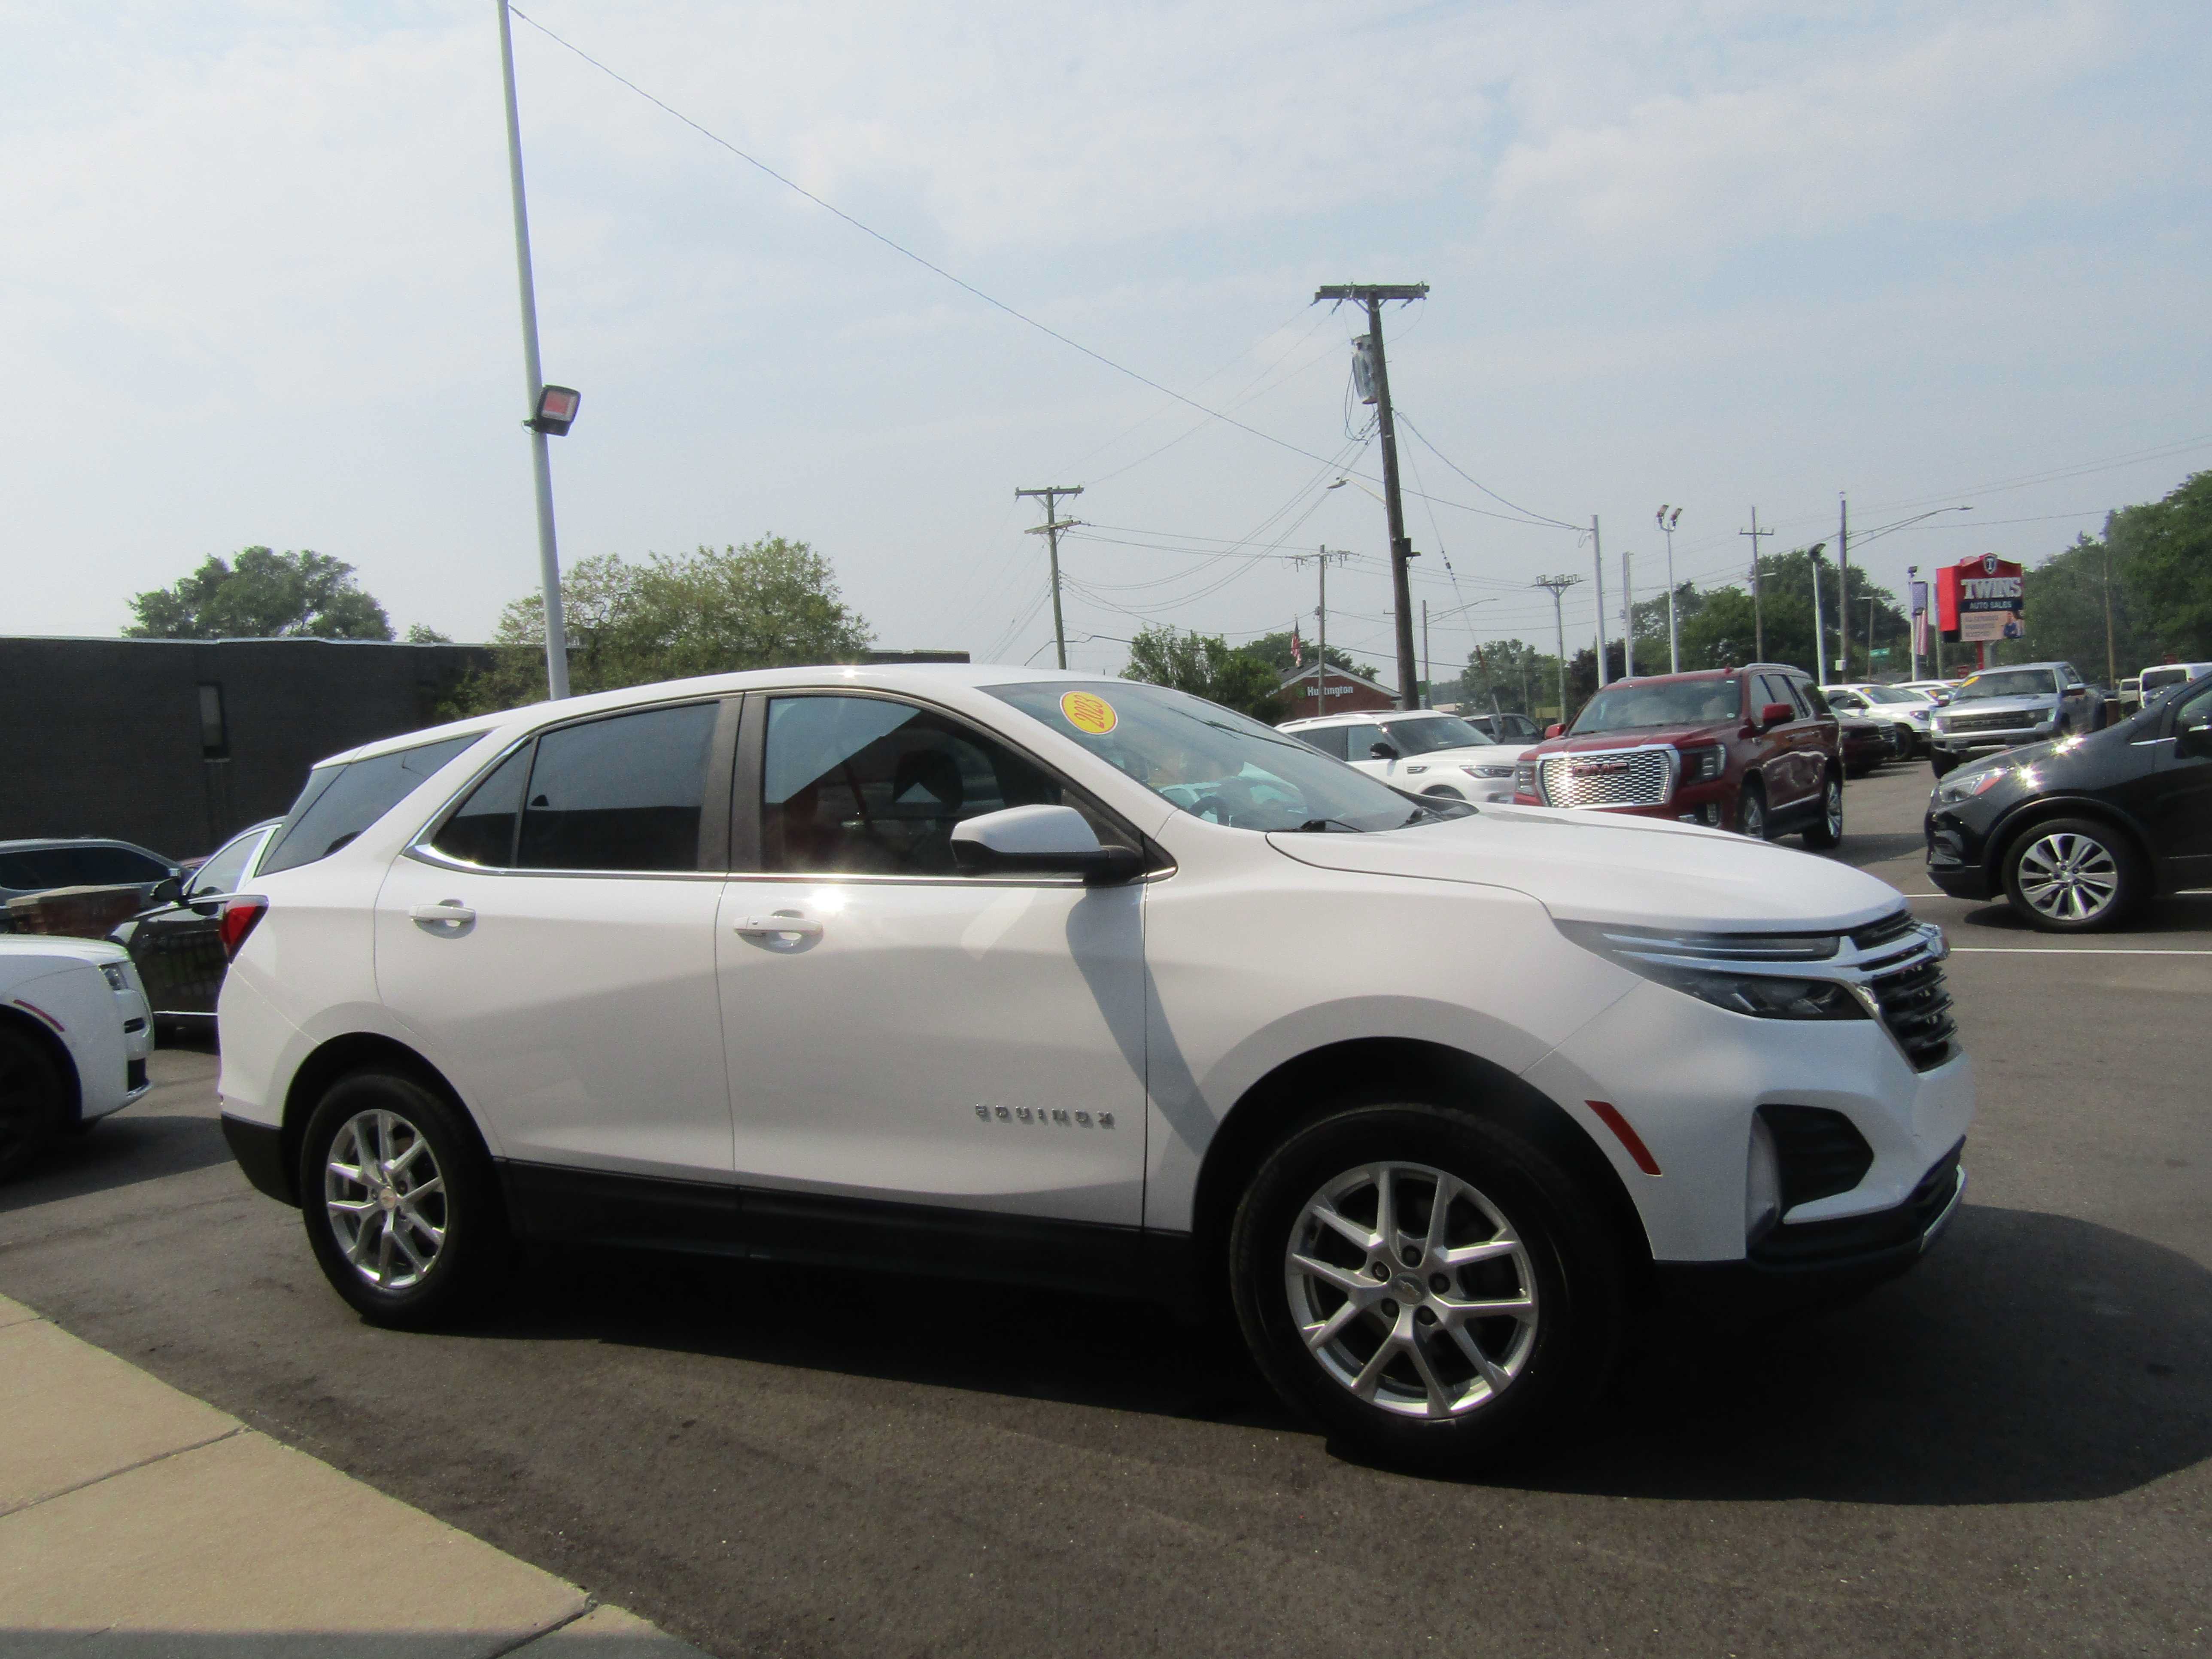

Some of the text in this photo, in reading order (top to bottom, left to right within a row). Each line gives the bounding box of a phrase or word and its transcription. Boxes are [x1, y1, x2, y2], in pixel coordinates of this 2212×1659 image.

[1960, 577, 2022, 599] TWINS
[1307, 686, 1354, 697] Hutington
[1074, 695, 1104, 729] 2023
[1574, 763, 1628, 777] GMC
[975, 1103, 1113, 1123] EQUINOX
